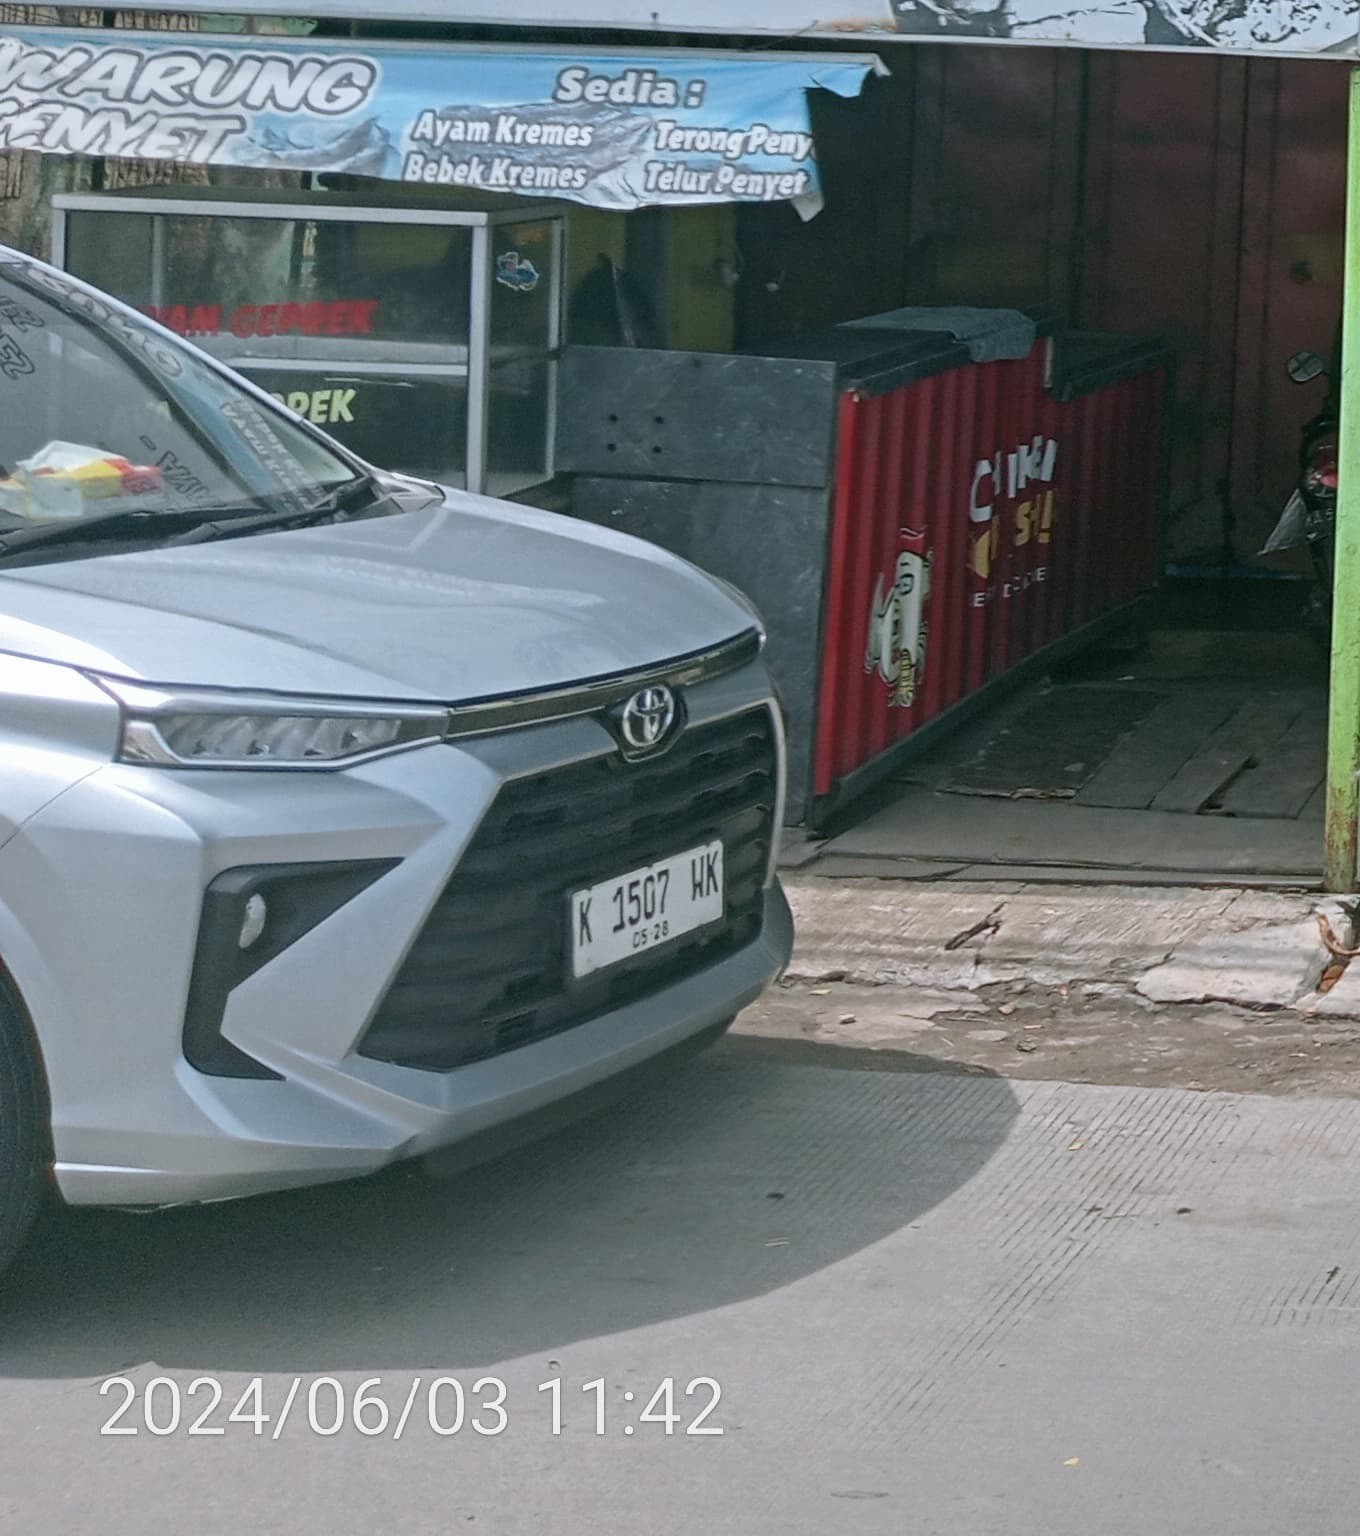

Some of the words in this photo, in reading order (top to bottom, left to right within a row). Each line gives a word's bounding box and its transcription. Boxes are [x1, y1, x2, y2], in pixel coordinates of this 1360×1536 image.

[553, 66, 679, 108] Sedia
[411, 109, 490, 147] Ayam
[494, 114, 594, 148] Kremes
[655, 119, 747, 161] Terong
[747, 122, 817, 162] Peny
[403, 152, 486, 185] Bebek
[487, 156, 589, 190] Kremes
[644, 158, 714, 195] Telur
[712, 163, 810, 201] Penyet
[579, 896, 592, 947] K
[612, 868, 670, 934] 1507
